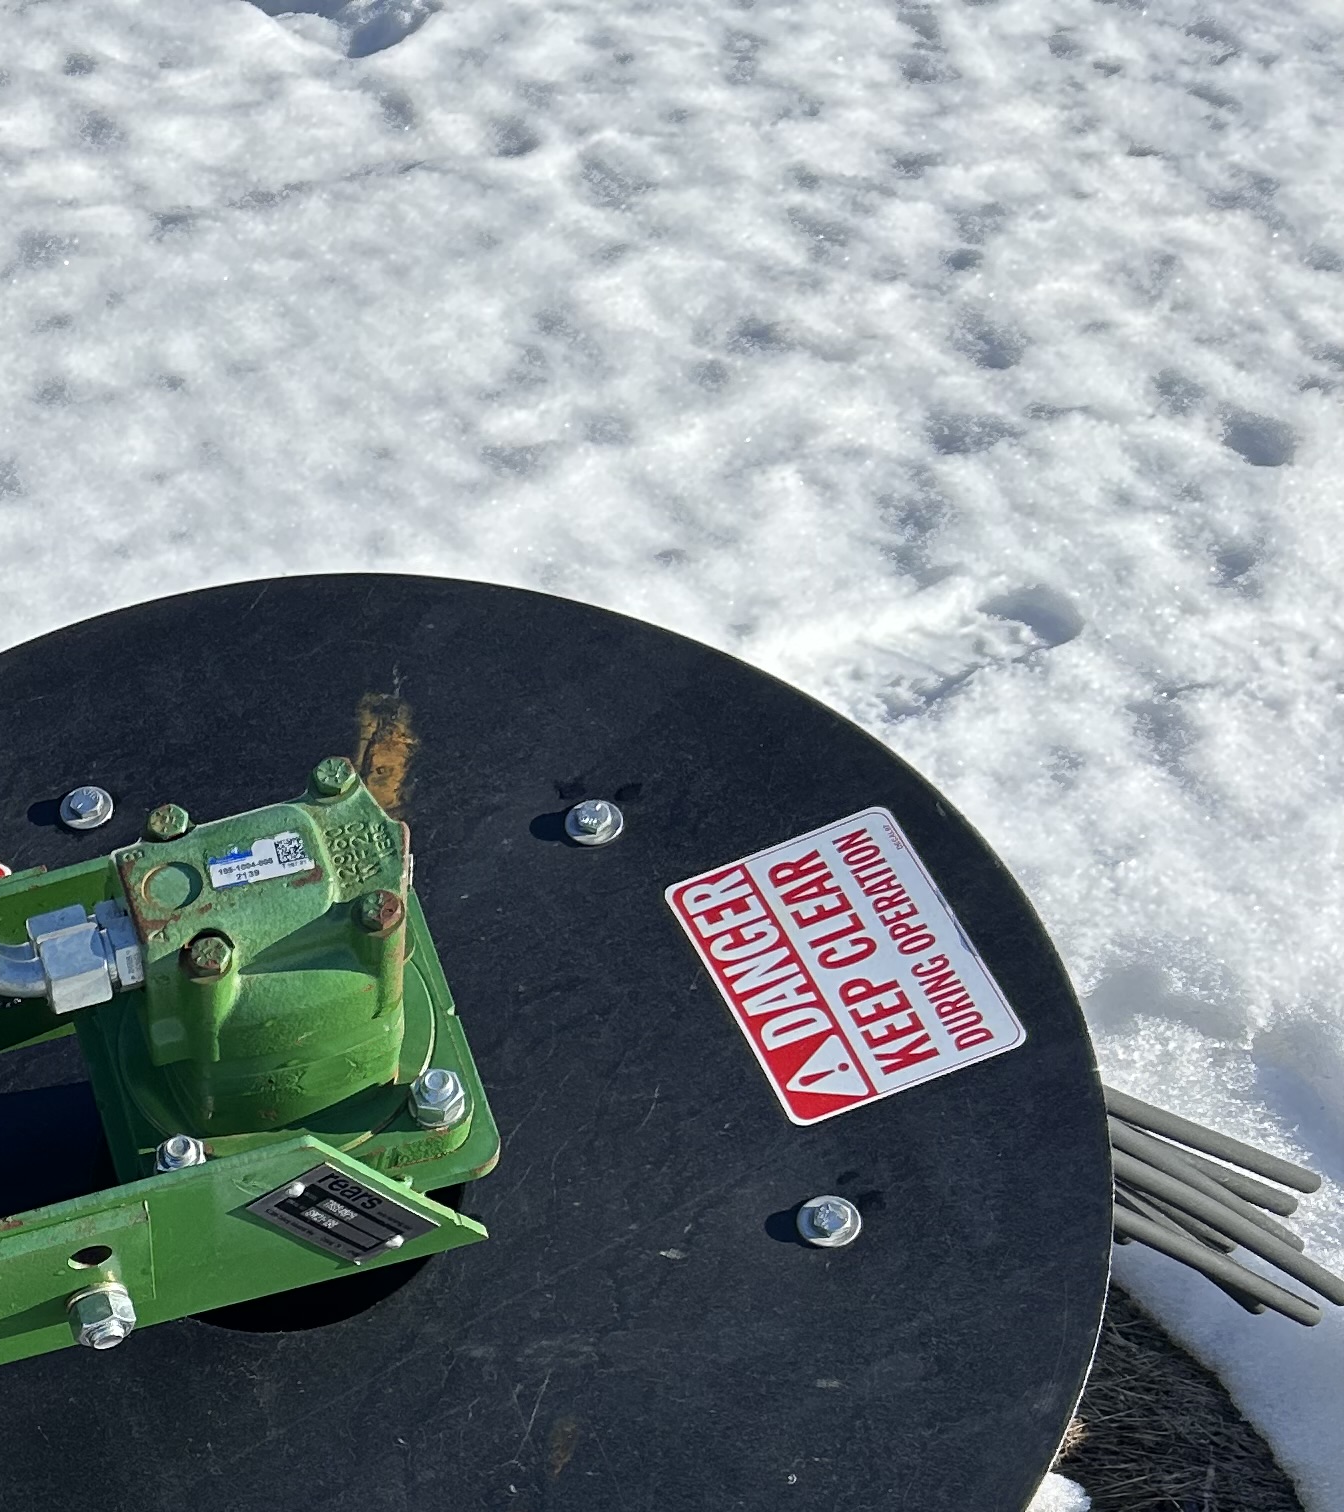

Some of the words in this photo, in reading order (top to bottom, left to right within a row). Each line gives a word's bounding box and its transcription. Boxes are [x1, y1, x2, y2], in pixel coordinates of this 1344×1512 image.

[767, 849, 878, 970] CLEAR
[832, 827, 936, 955] OPERATION
[682, 870, 832, 1051] DANGER
[911, 953, 994, 1052] DURING
[838, 978, 940, 1076] KEEP
[318, 1170, 383, 1210] rears
